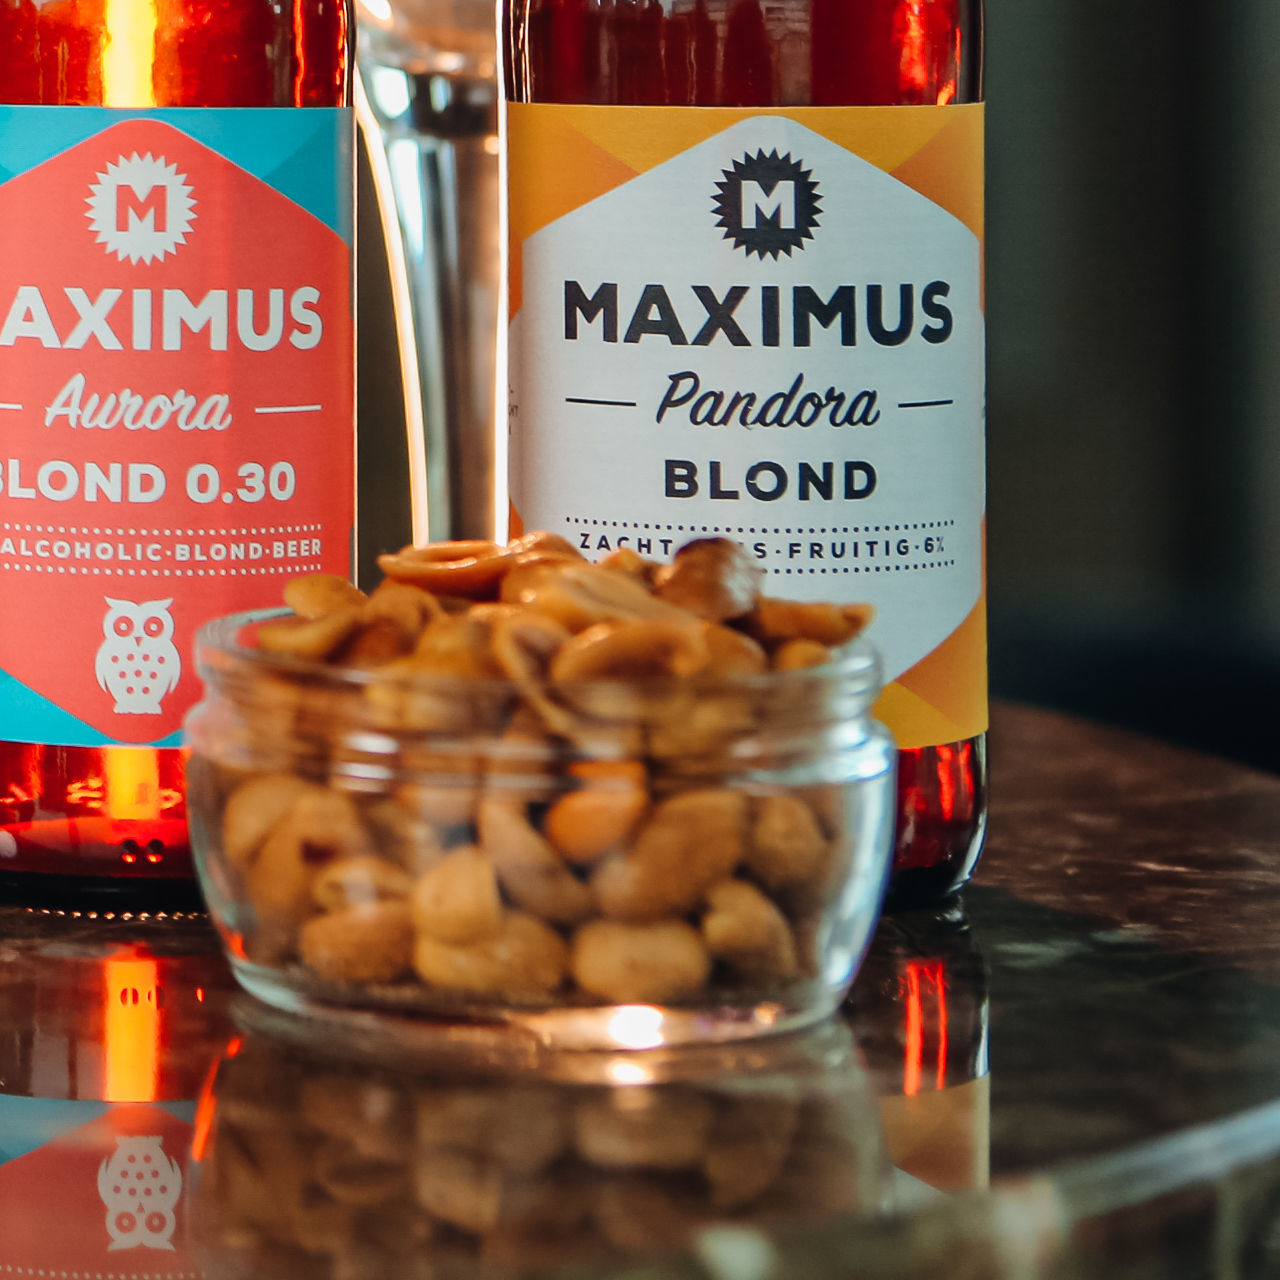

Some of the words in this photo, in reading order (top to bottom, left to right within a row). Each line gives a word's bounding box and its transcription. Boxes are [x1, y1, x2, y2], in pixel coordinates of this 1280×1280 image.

[115, 184, 169, 233] M
[741, 180, 796, 230] M
[564, 279, 954, 348] MAXIMUS
[44, 372, 234, 432] Aurora
[655, 370, 881, 428] Pandora
[185, 461, 297, 504] 0.30
[664, 459, 878, 502] BLOND
